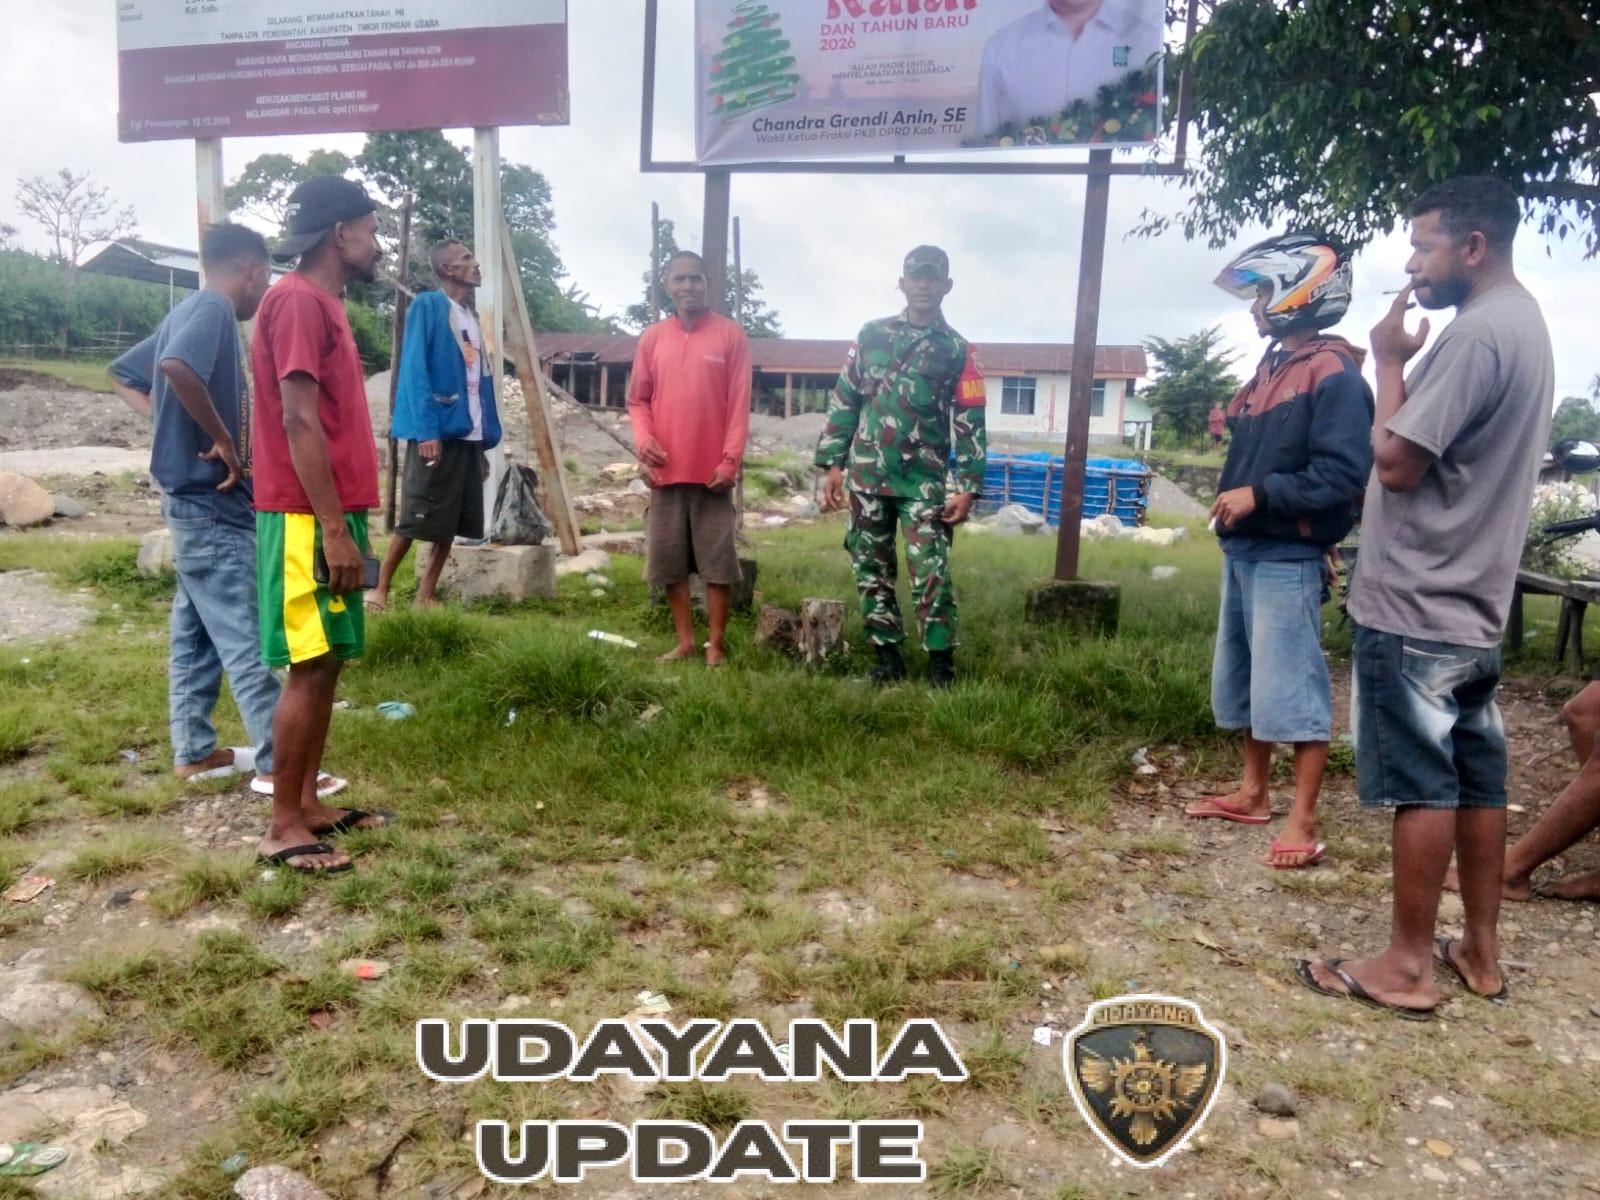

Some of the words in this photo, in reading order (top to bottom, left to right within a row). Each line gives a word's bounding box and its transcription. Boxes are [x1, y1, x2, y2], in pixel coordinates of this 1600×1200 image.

[394, 7, 405, 16] INI
[357, 22, 379, 32] TIMOR
[820, 22, 855, 36] DAN
[861, 18, 918, 33] TAHUN
[924, 15, 969, 30] BARU
[819, 36, 856, 51] 2026
[752, 115, 825, 133] Chandra
[829, 110, 888, 128] Grendi
[892, 108, 938, 126] Anin,
[943, 107, 967, 122] SE
[756, 130, 785, 144] Wakil
[787, 129, 818, 142] Ketua
[820, 127, 851, 141] Fraksi
[854, 128, 877, 138] PKB
[879, 126, 911, 137] DPRD
[913, 124, 937, 136] Kab.
[941, 123, 963, 134] TTU
